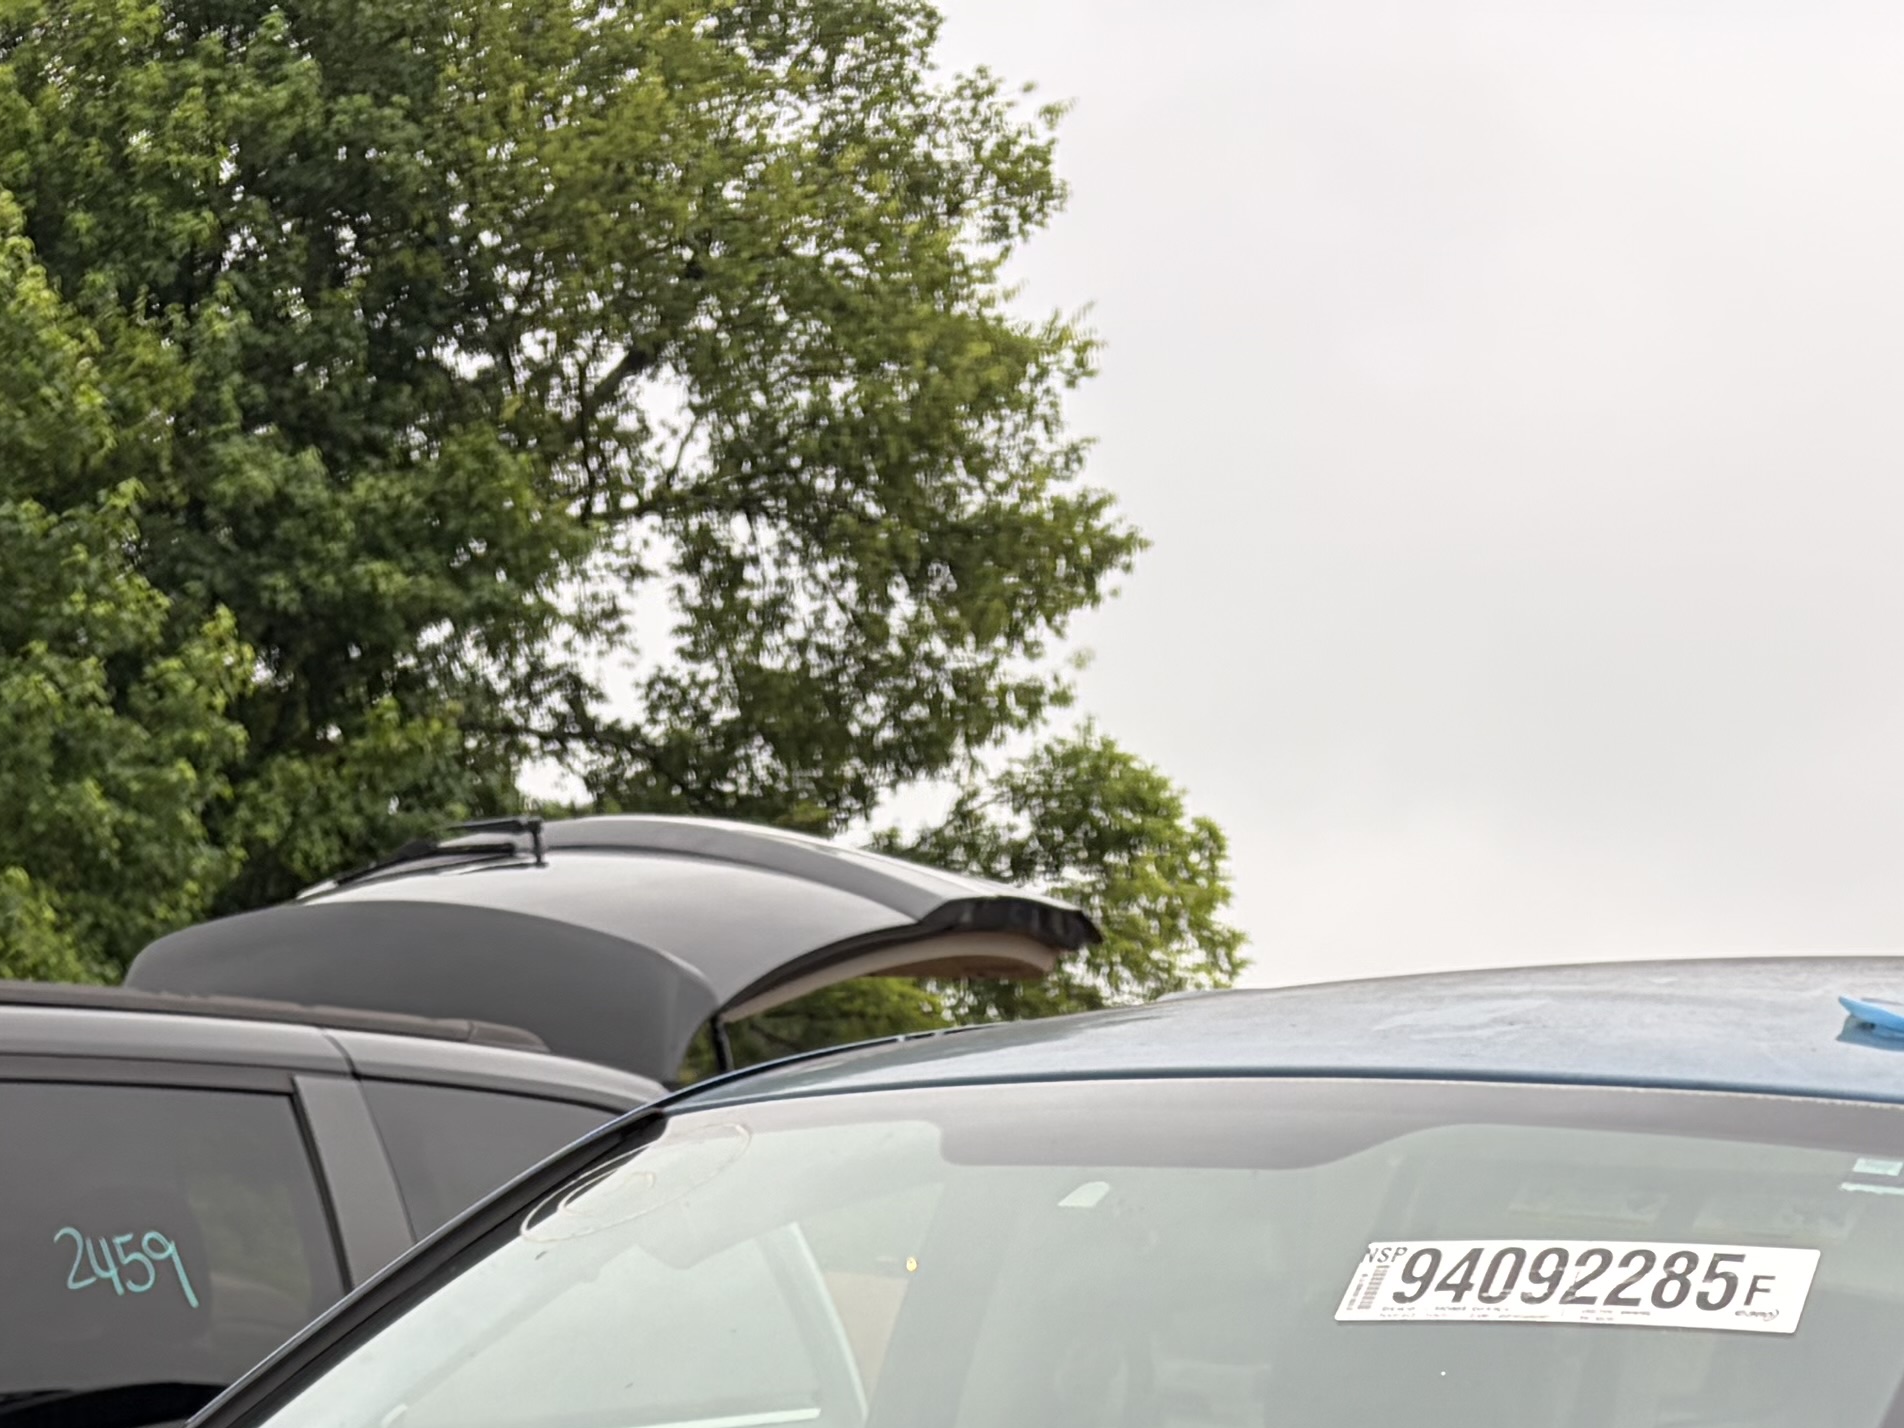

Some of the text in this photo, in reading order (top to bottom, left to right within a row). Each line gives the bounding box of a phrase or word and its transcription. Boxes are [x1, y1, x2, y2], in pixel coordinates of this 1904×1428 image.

[53, 1227, 199, 1309] 2459
[1392, 1246, 1746, 1312] 94092285
[1743, 1274, 1777, 1307] F
